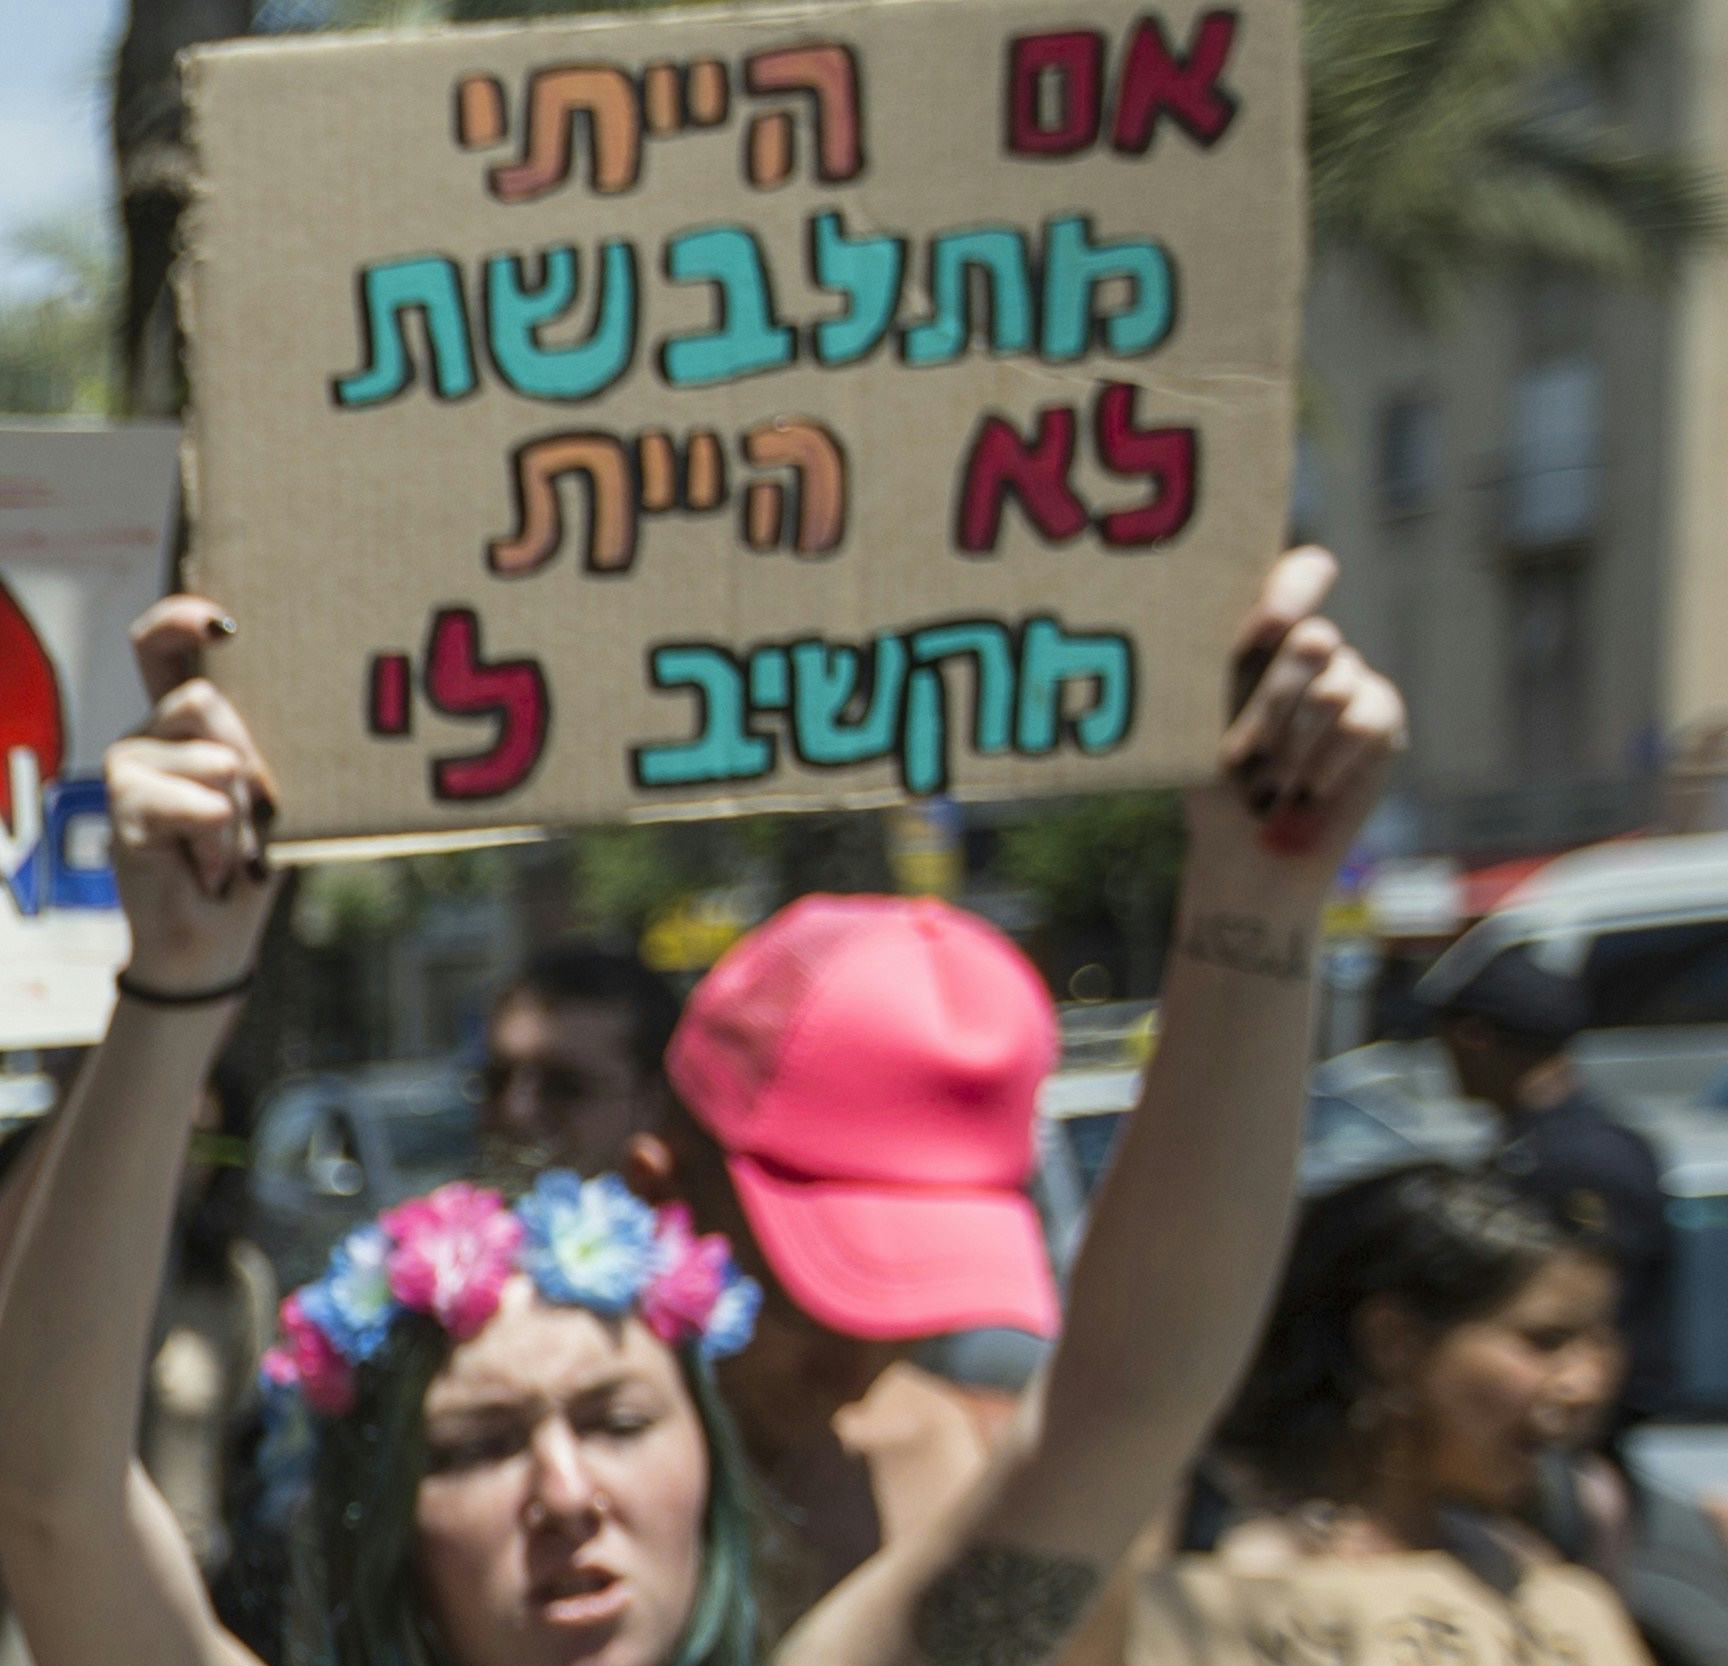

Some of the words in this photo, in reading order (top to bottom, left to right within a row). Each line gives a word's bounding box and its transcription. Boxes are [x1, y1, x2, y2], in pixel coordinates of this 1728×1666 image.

[452, 38, 872, 202] הייתי
[1004, 8, 1242, 160] אם
[329, 208, 1184, 410] מתלבשת
[482, 412, 850, 580] היית
[952, 378, 1202, 560] לא
[366, 606, 552, 802] לי
[628, 612, 1138, 800] מקשיב
